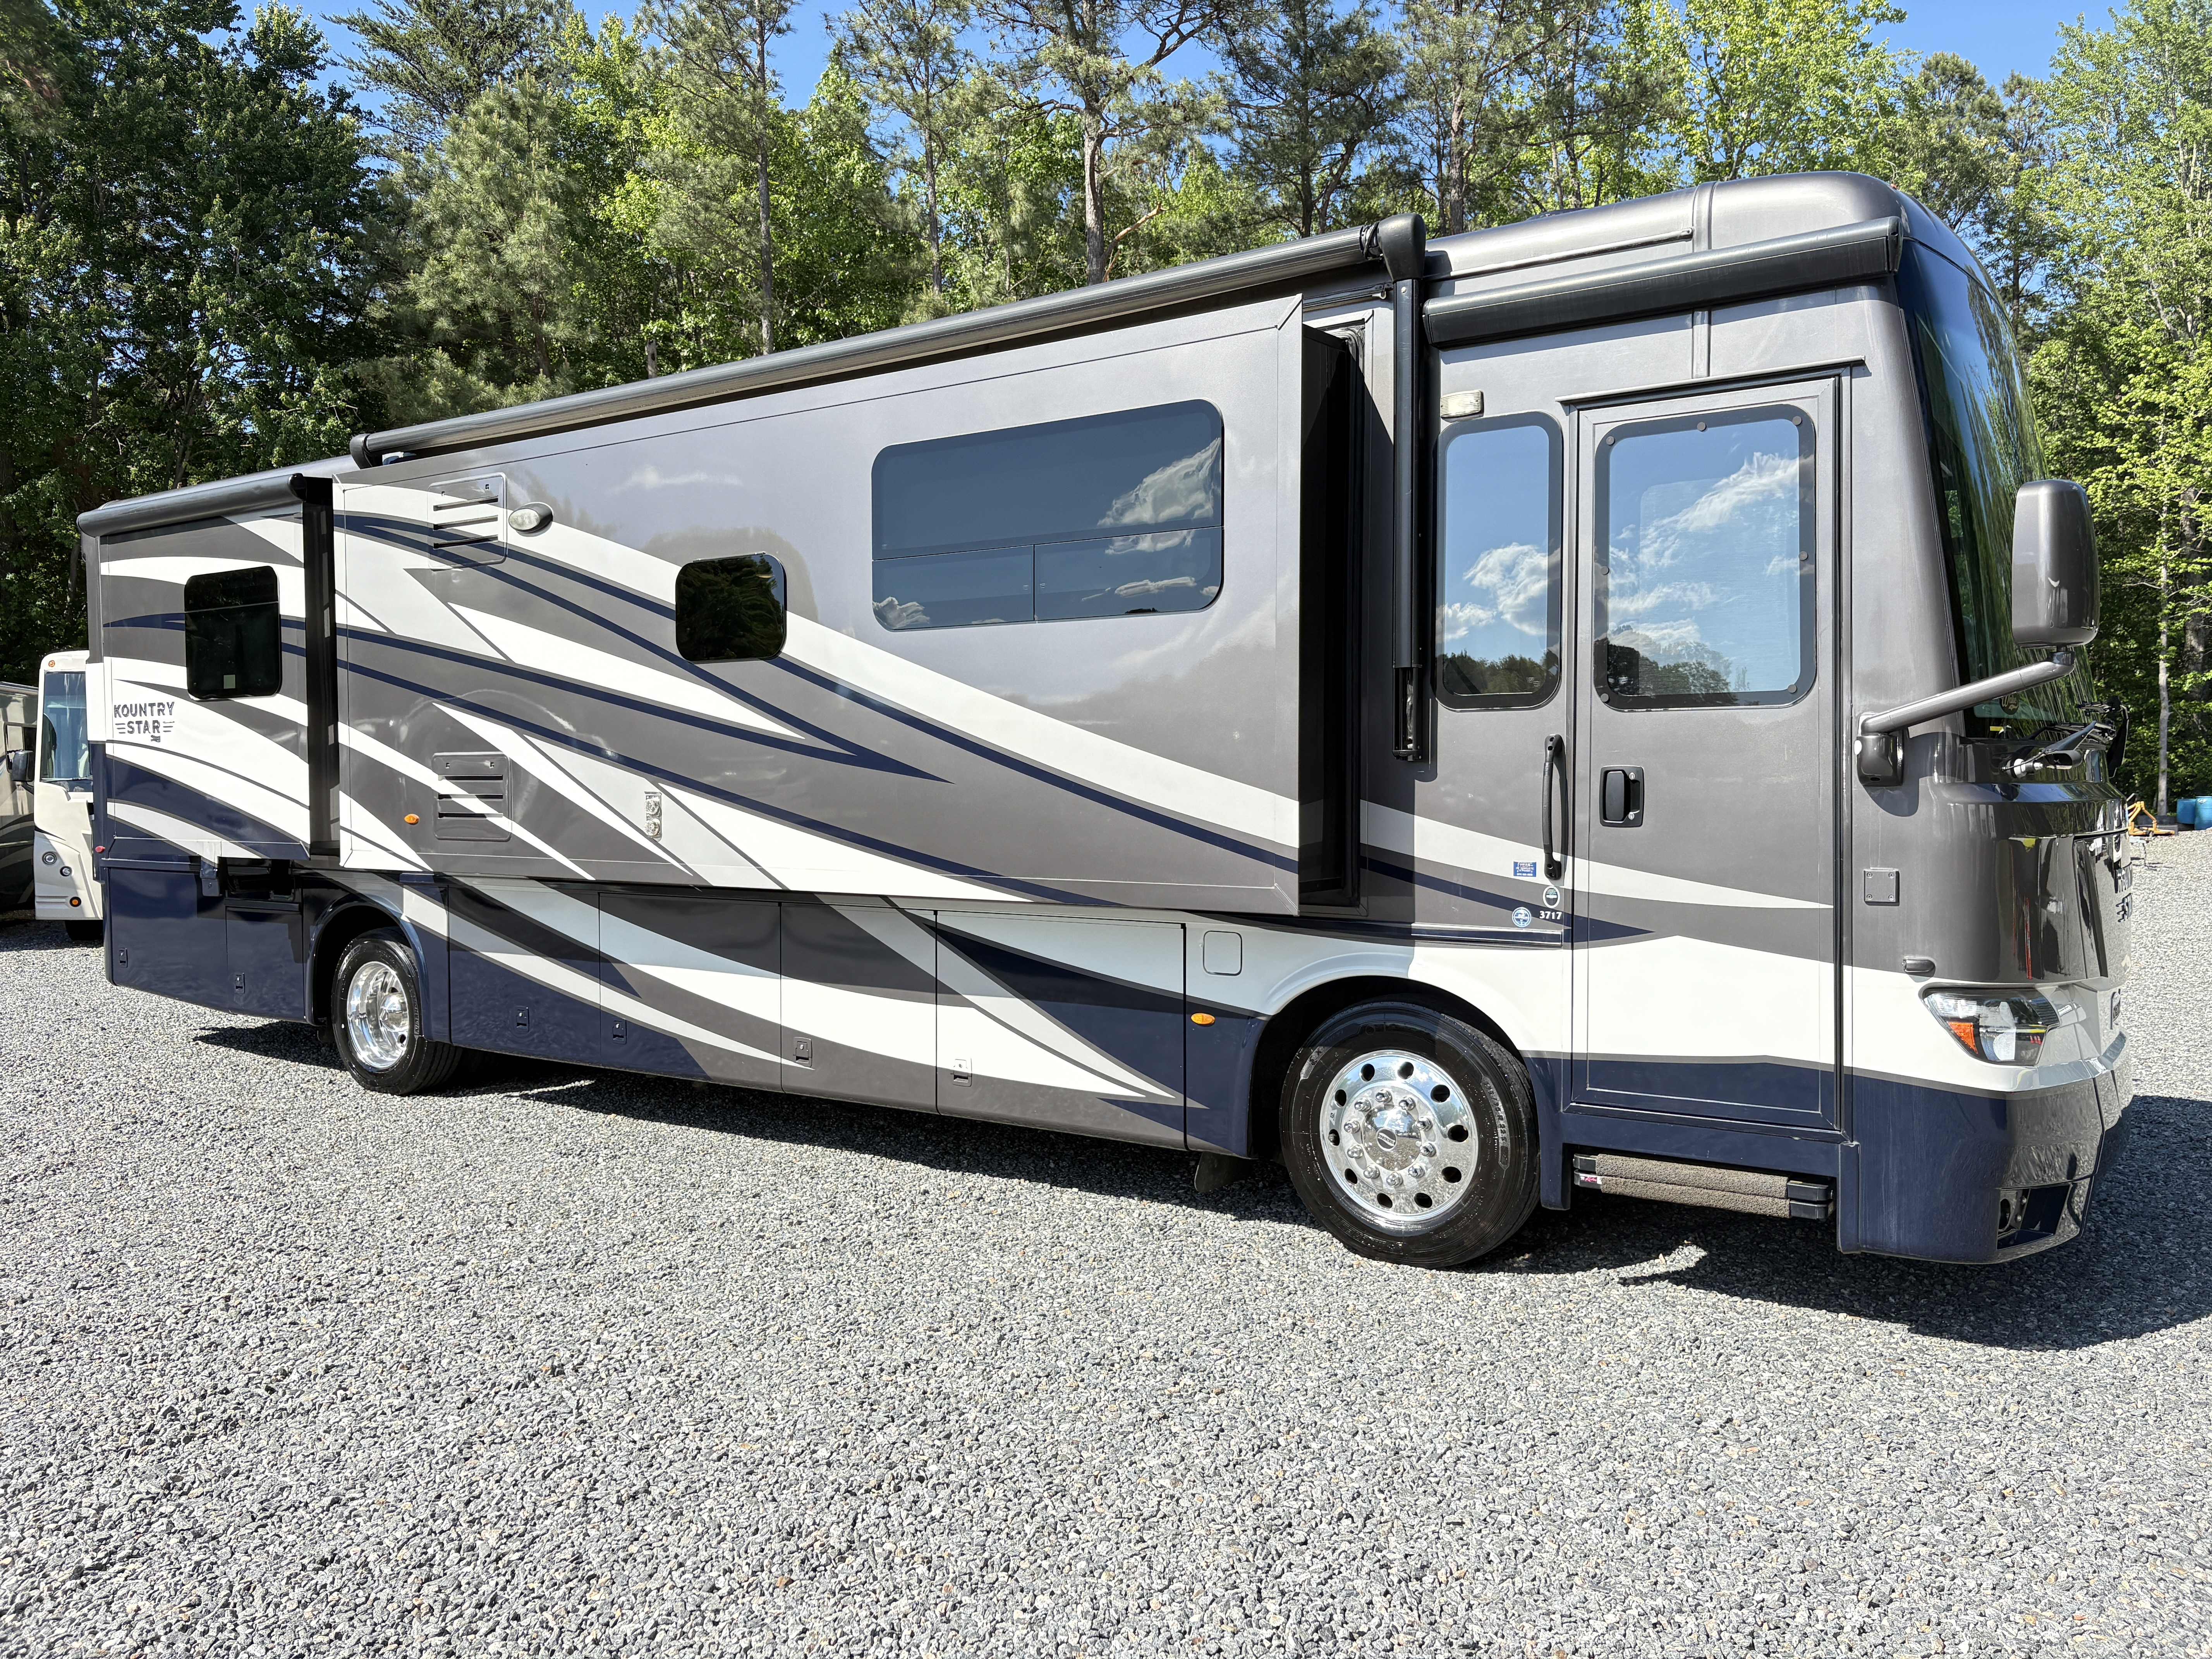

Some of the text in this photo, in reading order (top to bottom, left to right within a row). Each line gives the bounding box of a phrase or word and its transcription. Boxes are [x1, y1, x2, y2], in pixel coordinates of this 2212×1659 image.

[114, 701, 175, 718] KOUNTRY
[127, 720, 160, 734] STAR
[1539, 910, 1562, 920] 3717
